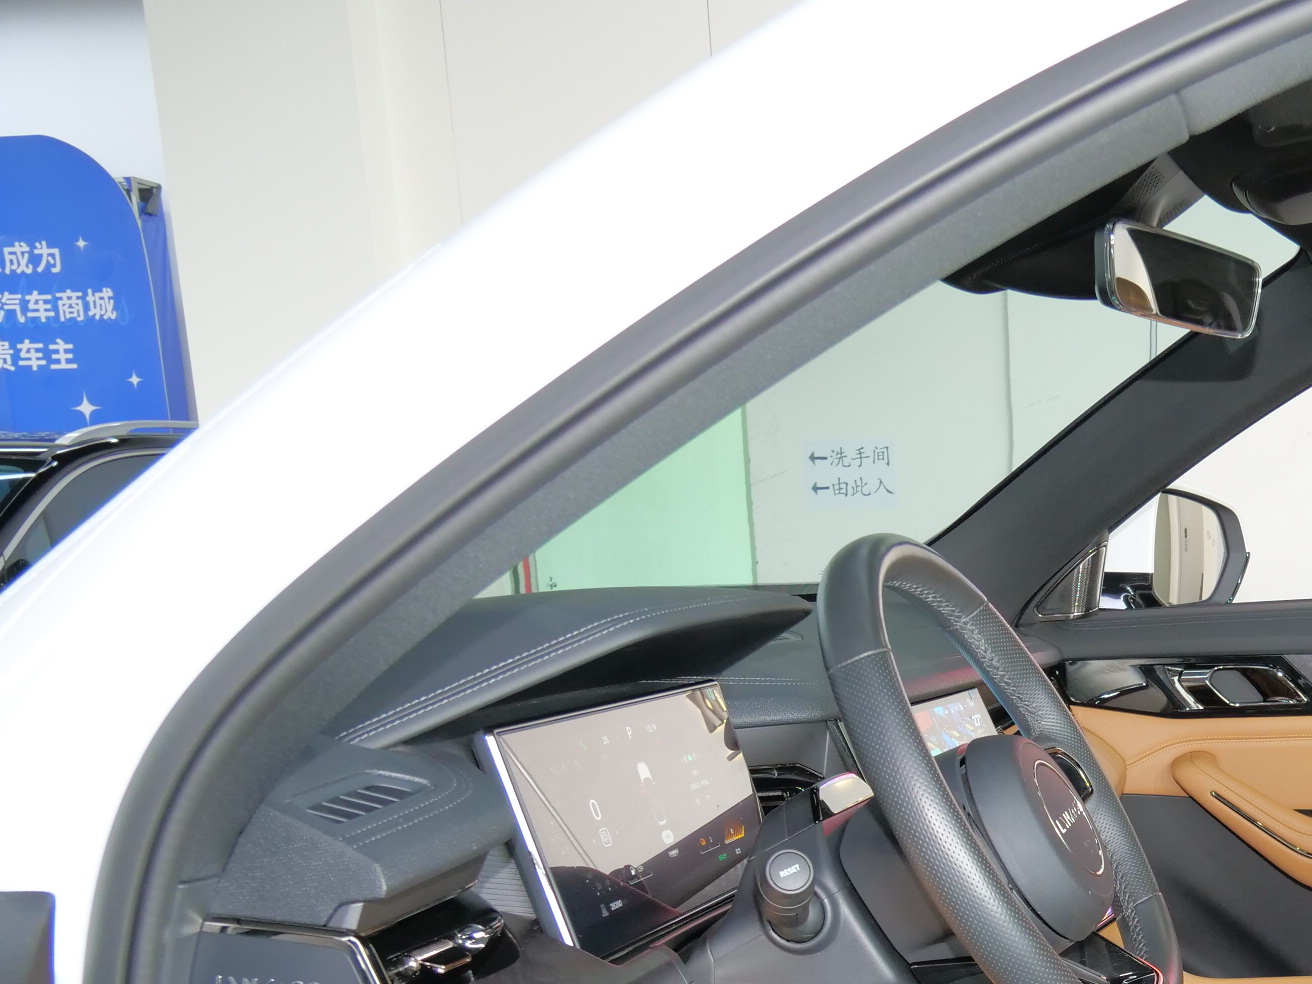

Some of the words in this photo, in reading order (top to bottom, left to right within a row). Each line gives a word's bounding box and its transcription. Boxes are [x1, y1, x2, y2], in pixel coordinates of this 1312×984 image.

[830, 446, 891, 468] 洗手间
[832, 477, 895, 498] 由此入
[779, 863, 801, 878] RESET
